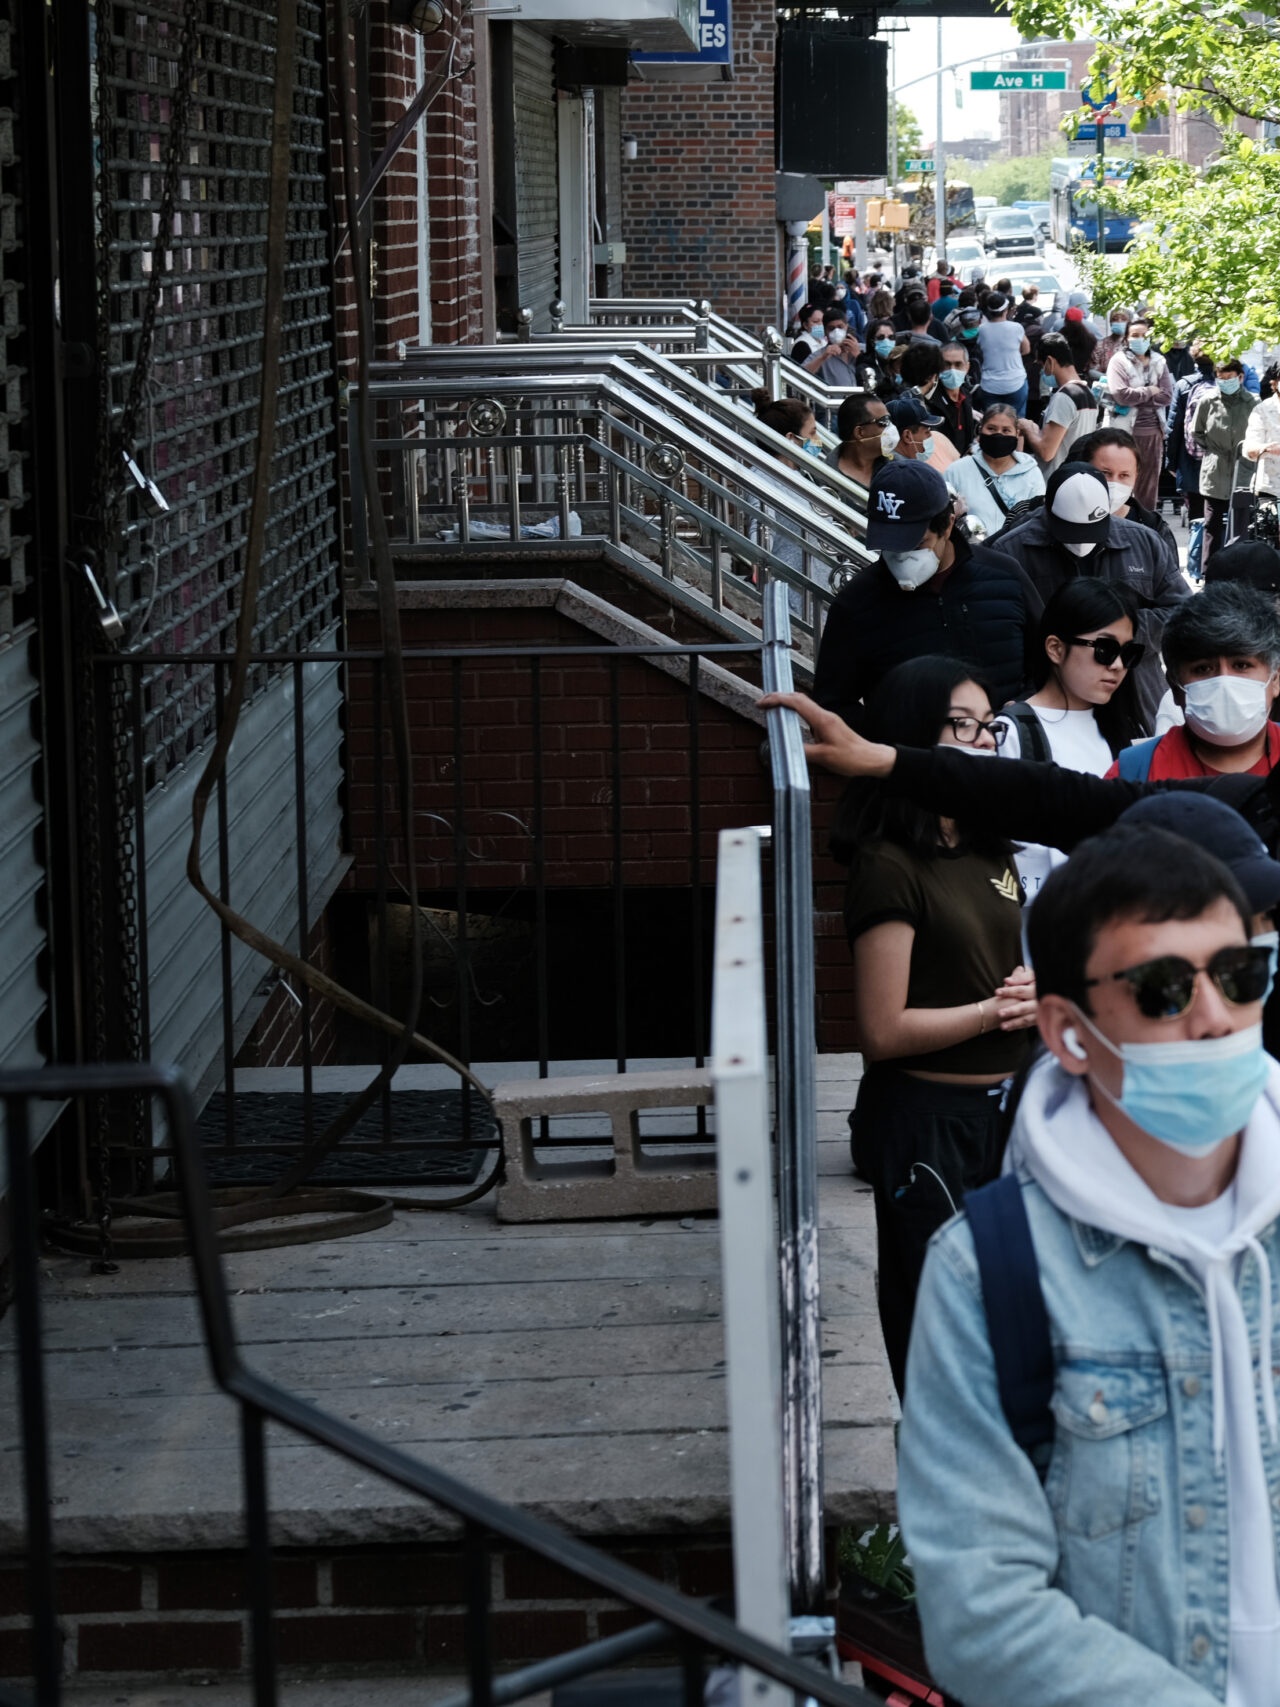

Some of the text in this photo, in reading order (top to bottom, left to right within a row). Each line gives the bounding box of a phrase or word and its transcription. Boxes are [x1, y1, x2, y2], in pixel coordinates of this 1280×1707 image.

[698, 22, 727, 48] ES
[993, 73, 1044, 88] Ave H
[876, 490, 906, 520] NY
